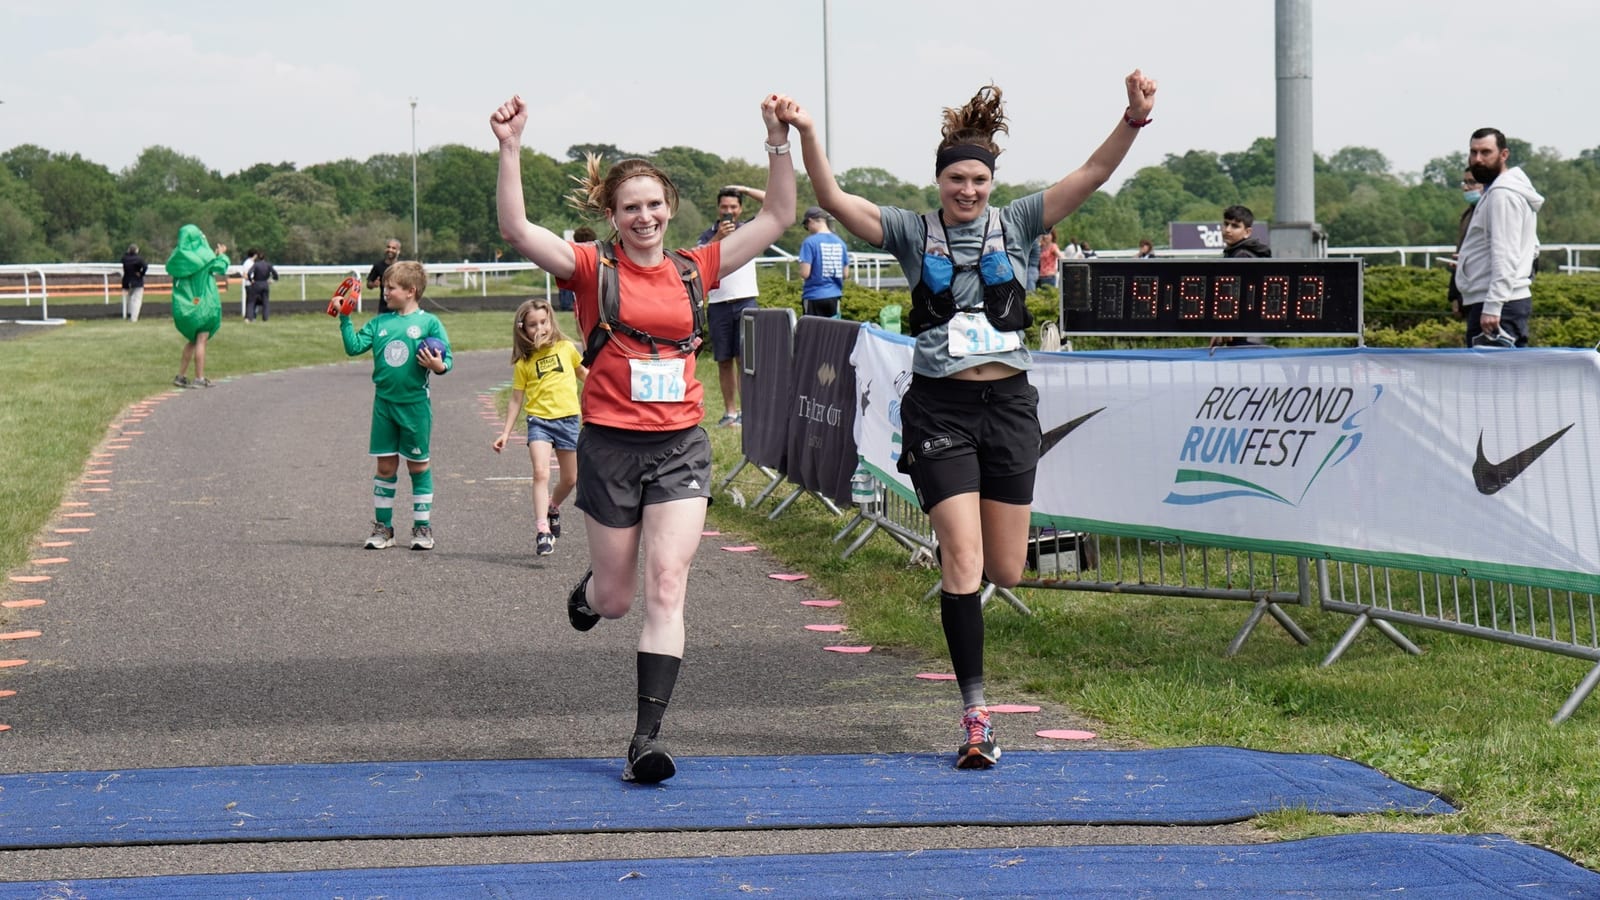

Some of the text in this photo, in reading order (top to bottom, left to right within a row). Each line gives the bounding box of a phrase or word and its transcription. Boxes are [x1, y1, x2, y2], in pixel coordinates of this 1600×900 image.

[1132, 276, 1324, 320] 4:56:02
[966, 328, 1005, 352] 315
[640, 374, 680, 400] 314
[1195, 386, 1354, 424] RICHMOND
[1179, 425, 1316, 467] RUNFEST
